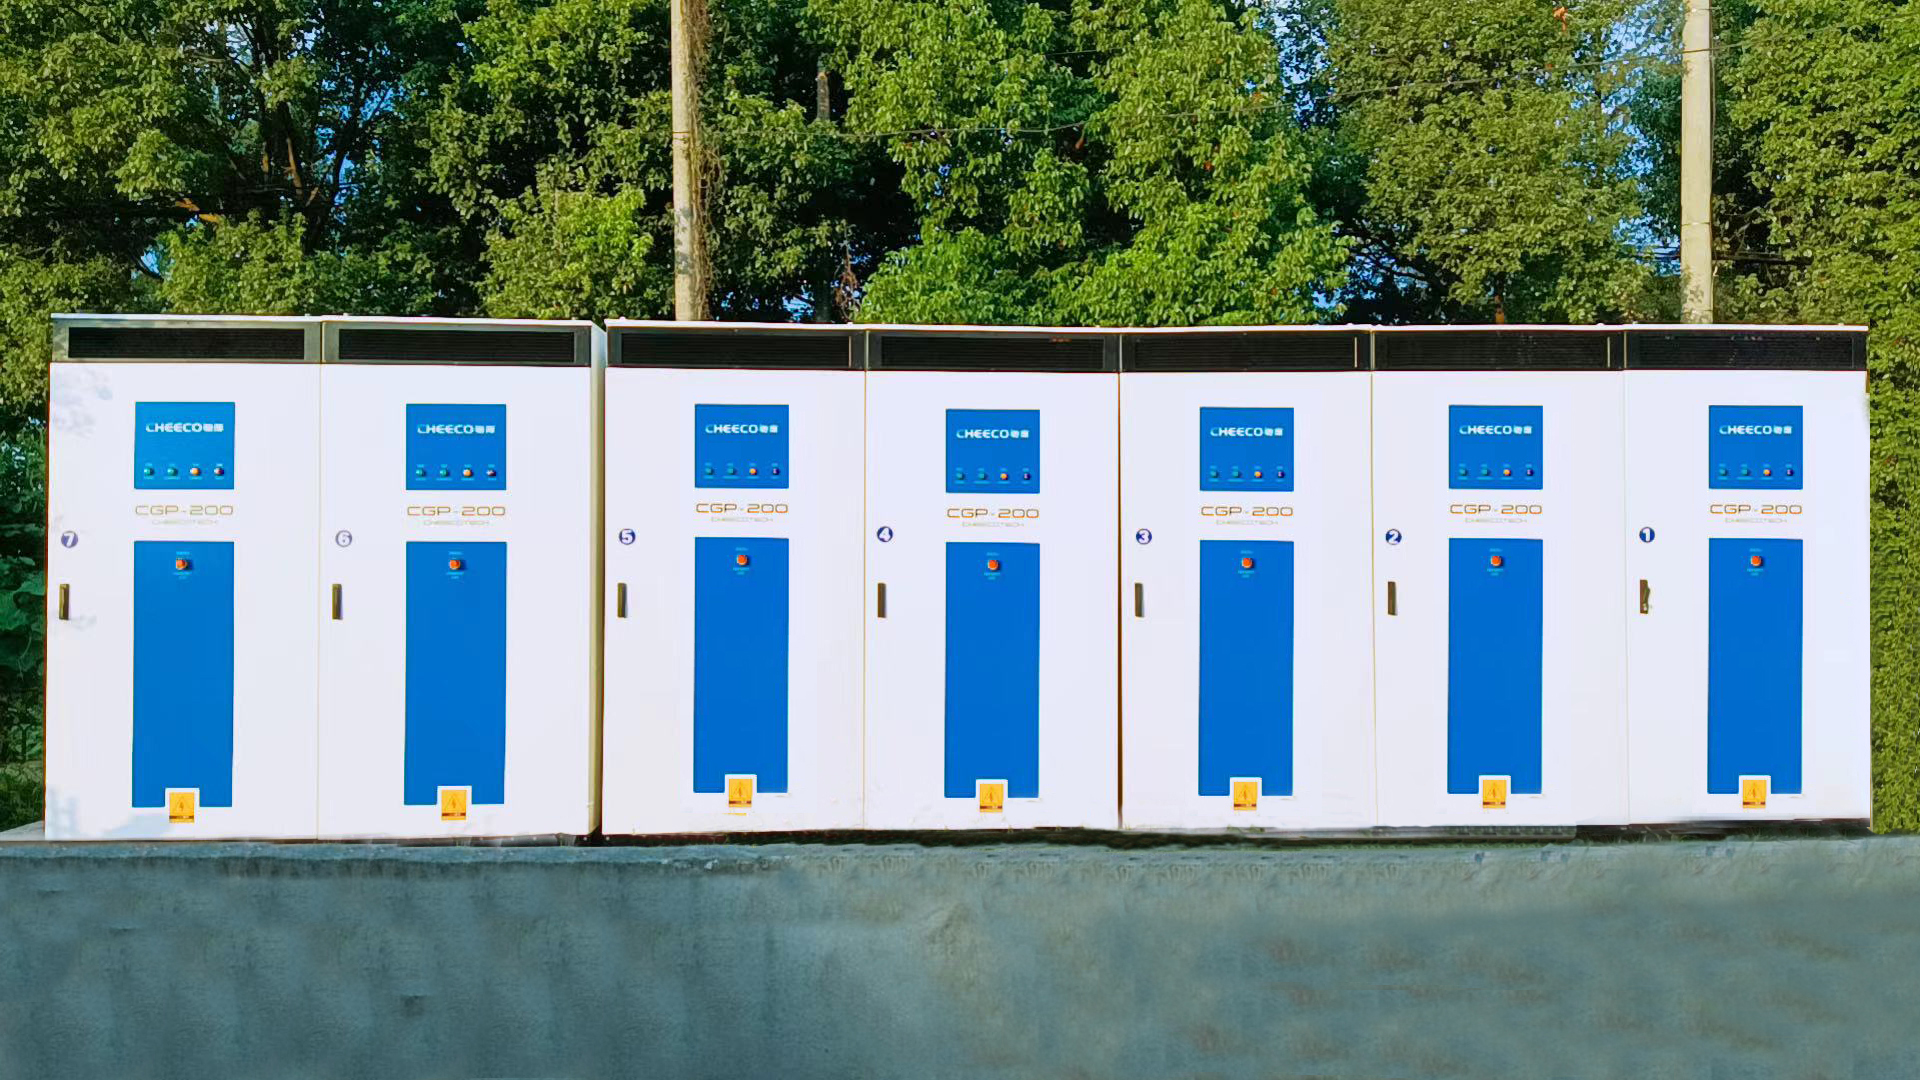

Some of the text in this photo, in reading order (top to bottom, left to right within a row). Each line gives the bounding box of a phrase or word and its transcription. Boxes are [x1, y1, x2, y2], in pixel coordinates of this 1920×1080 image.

[145, 422, 202, 433] CHEECO
[417, 423, 474, 434] CHEECO
[705, 424, 758, 434] CHEECO
[1210, 427, 1263, 437] CHEECO
[1459, 425, 1512, 435] CHEECO
[1719, 425, 1772, 435] CHEECO
[956, 429, 1009, 439] CHEECO
[135, 504, 234, 516] CGP-200
[407, 506, 506, 516] CGP-200
[696, 503, 788, 514] CGP-200
[947, 508, 1039, 519] CGP-200
[1201, 506, 1293, 517] CGP-200
[1450, 504, 1542, 515] CGP-200
[1710, 504, 1802, 515] CGP-200
